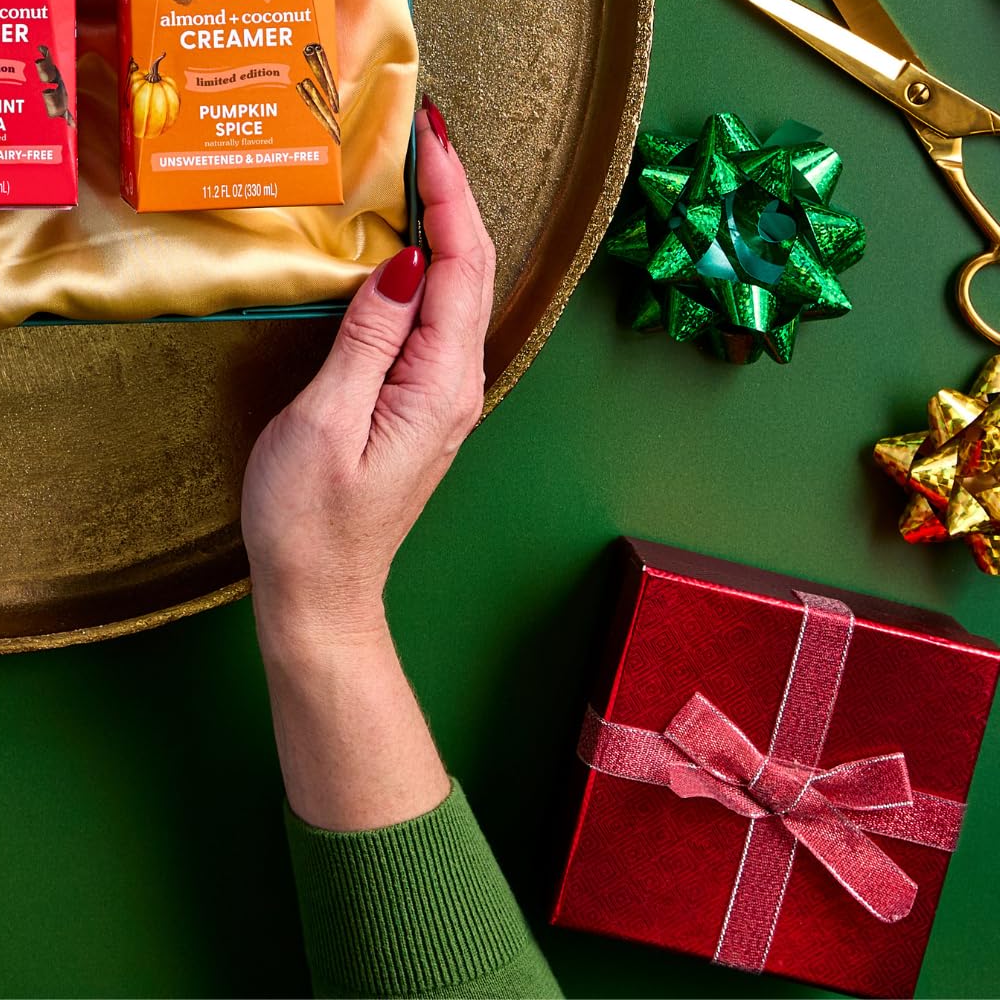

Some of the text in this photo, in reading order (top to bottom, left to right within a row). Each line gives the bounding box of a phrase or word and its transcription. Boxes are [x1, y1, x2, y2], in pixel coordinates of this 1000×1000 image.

[160, 9, 226, 27] almond
[242, 8, 311, 24] coconut
[180, 28, 292, 49] CREAMER
[196, 68, 280, 87] limited edition
[200, 103, 277, 119] PUMPKIN
[216, 121, 262, 136] SPICE
[204, 137, 273, 148] naturally flavored
[160, 152, 319, 167] UNSWEETENED & DAIRY-FREE
[202, 183, 277, 198] 11.2 FL OZ (330 mL)
